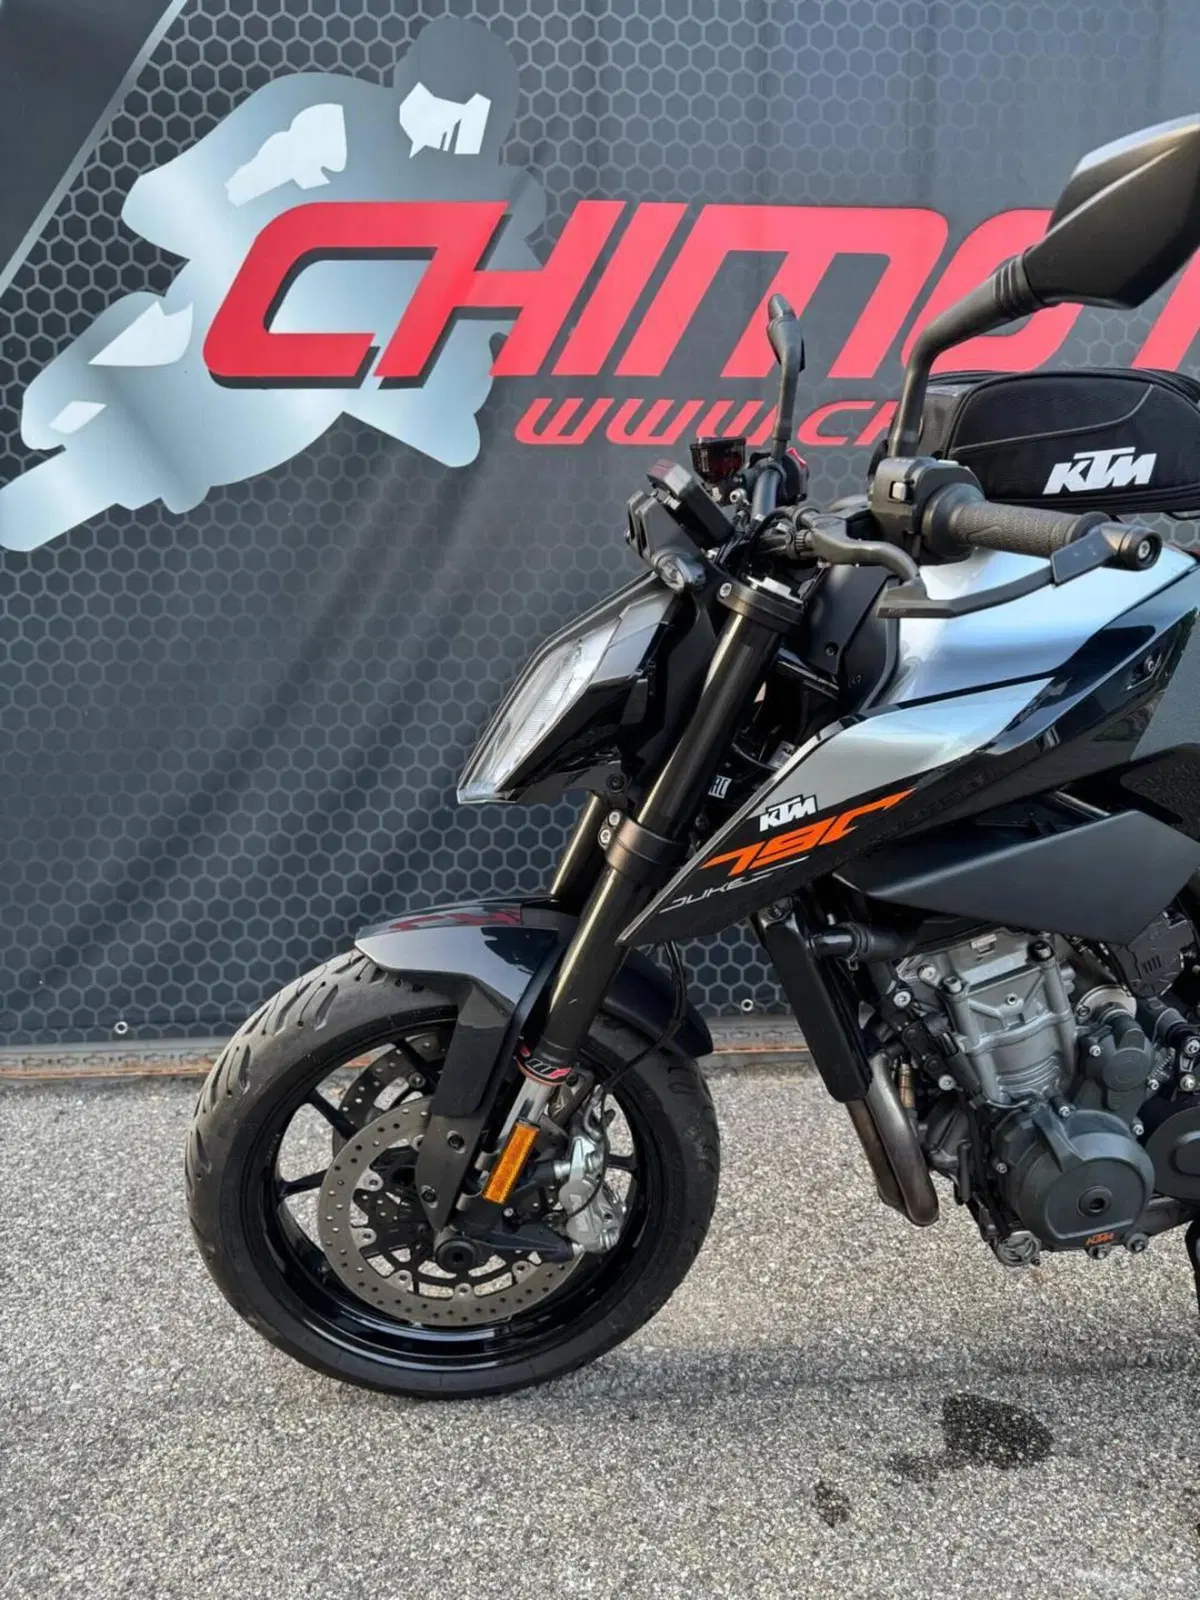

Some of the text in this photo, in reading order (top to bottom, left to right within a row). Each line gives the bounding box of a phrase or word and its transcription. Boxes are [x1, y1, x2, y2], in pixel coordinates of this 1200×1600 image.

[1042, 446, 1157, 495] KTM
[760, 796, 817, 832] KTM
[658, 861, 792, 914] DUKE
